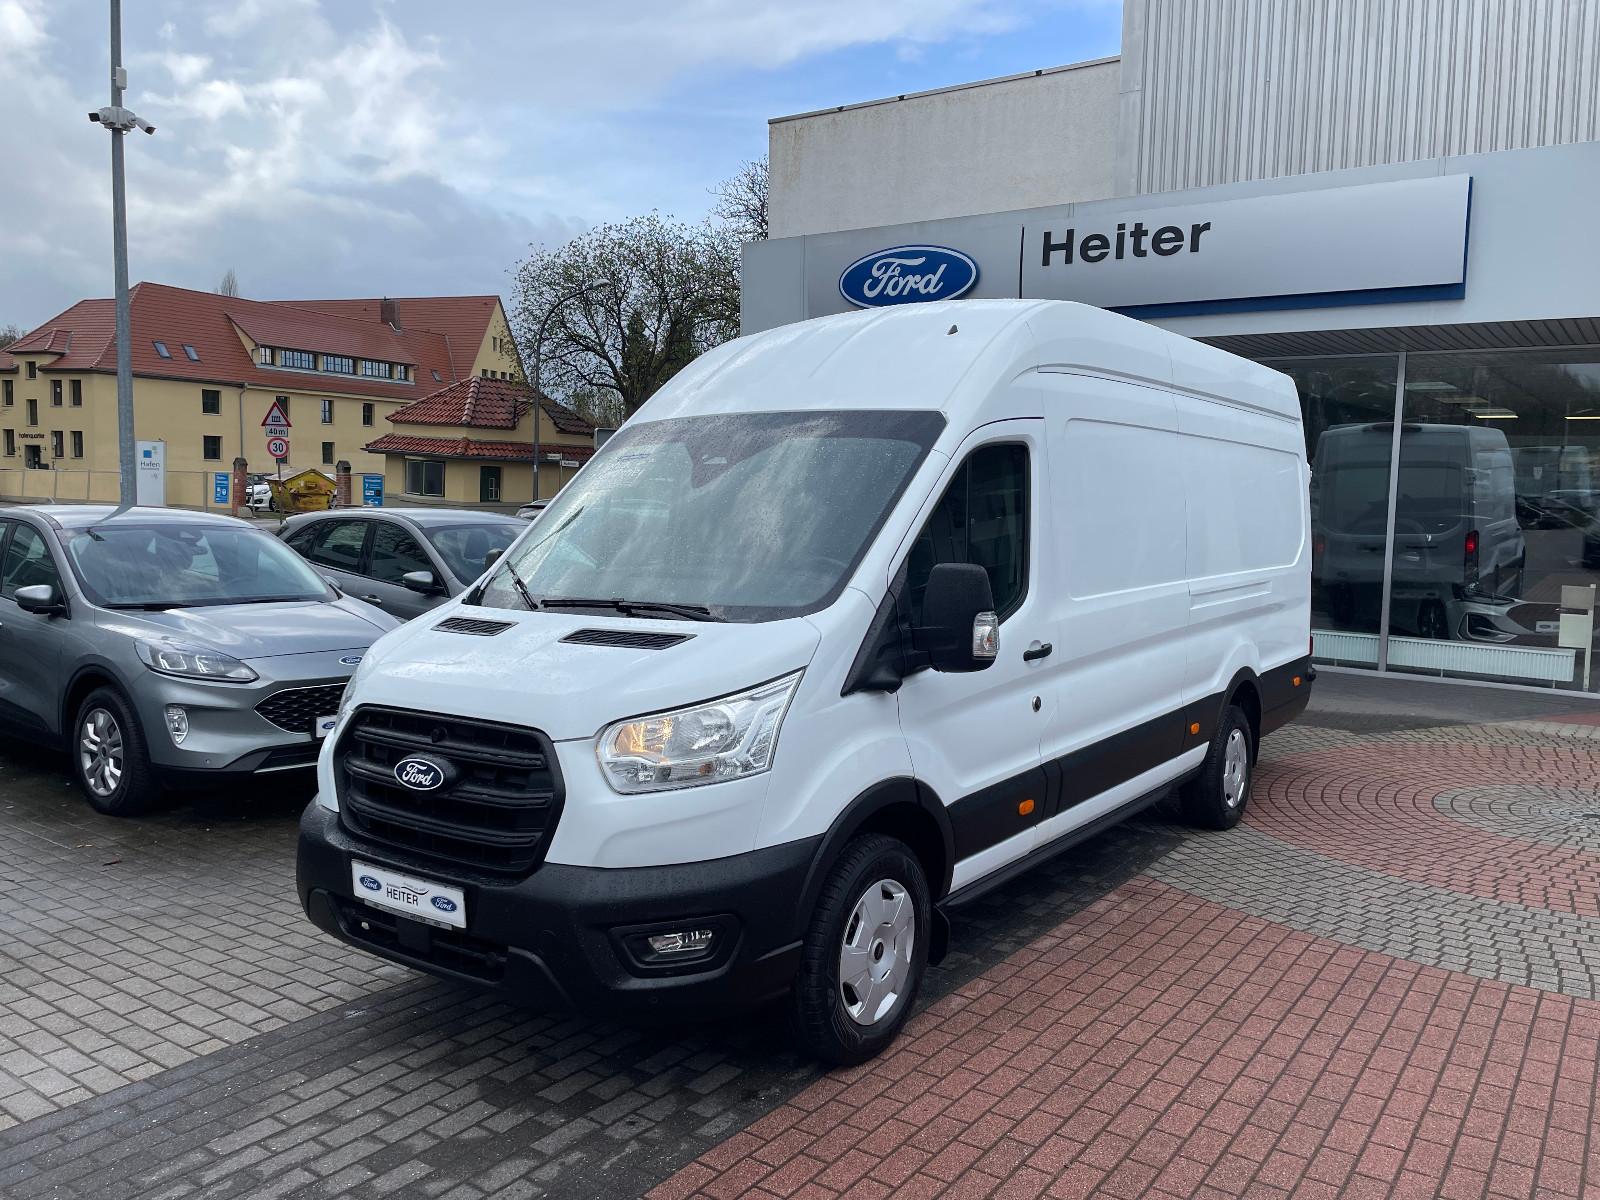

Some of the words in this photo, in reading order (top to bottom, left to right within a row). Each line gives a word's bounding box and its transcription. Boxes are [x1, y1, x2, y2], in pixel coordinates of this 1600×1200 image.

[1041, 221, 1212, 267] Heiter
[863, 256, 947, 299] Ford
[268, 427, 278, 435] 40
[272, 442, 284, 453] 30
[140, 460, 161, 468] Hafen
[402, 762, 434, 786] Ford
[363, 877, 379, 890] Ford
[386, 887, 419, 906] HEITER
[434, 897, 453, 911] Ford
